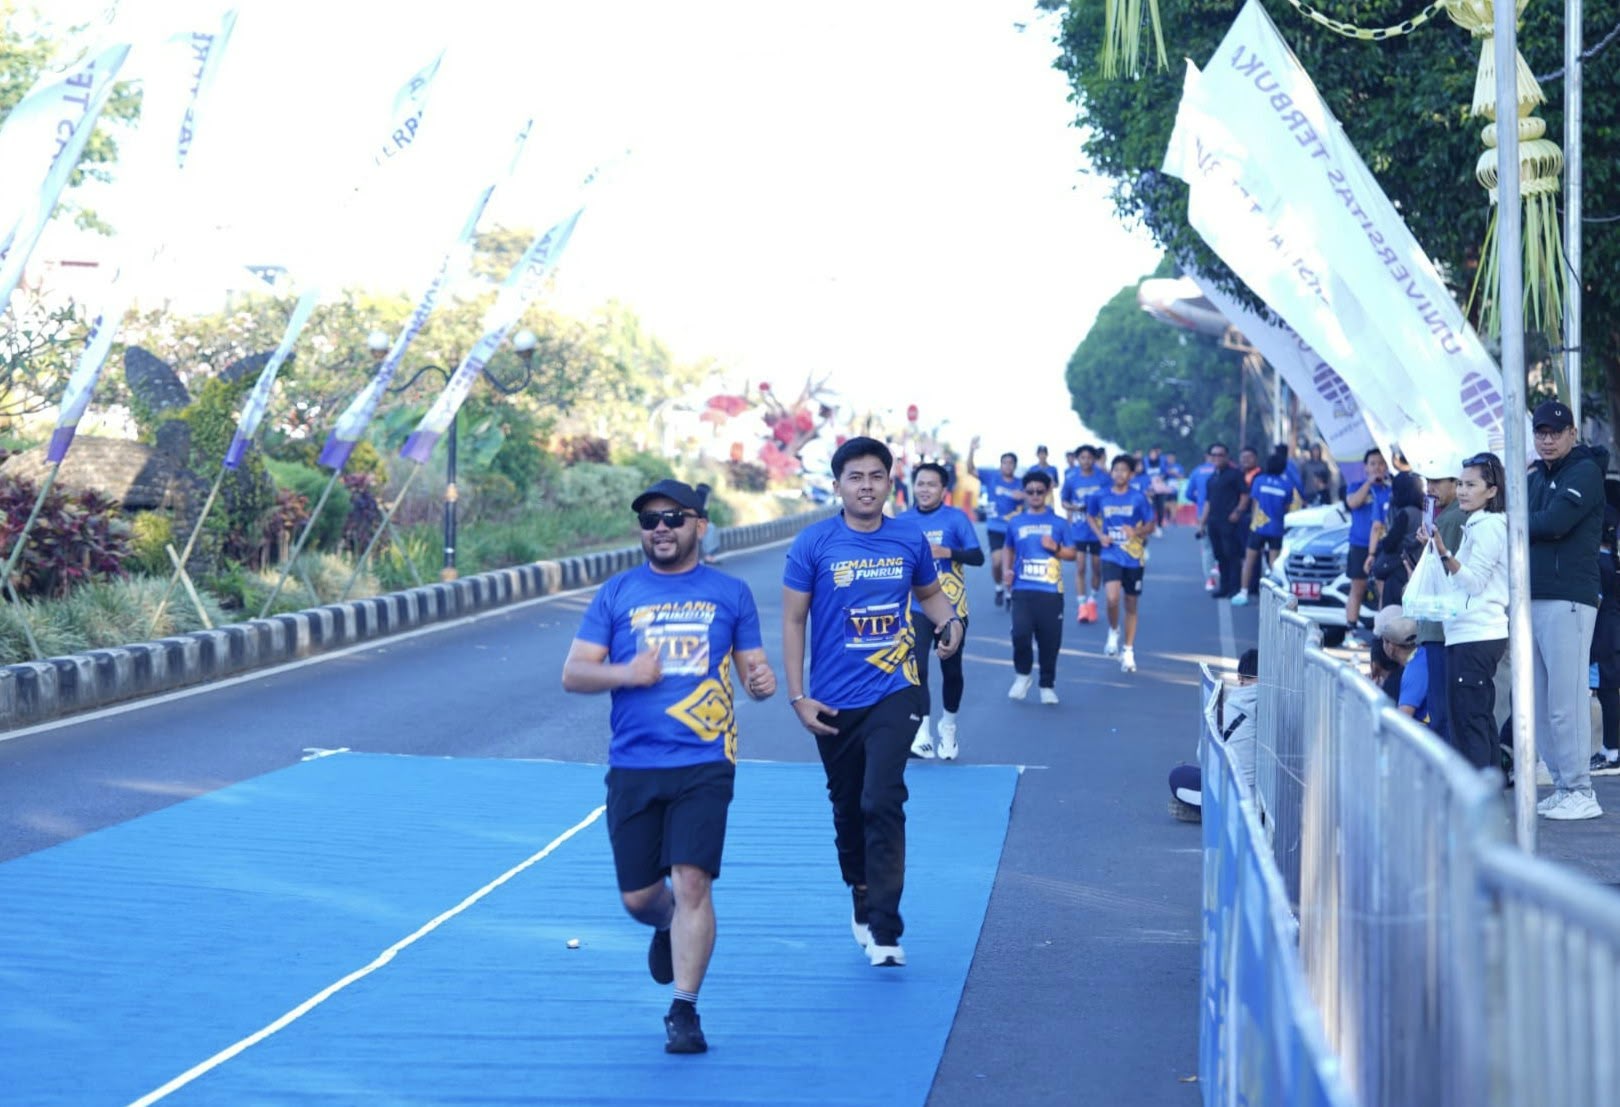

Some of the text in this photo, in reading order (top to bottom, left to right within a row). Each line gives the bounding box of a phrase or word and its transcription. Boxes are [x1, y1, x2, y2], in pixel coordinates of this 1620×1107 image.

[854, 566, 904, 581] FUNRUN
[850, 615, 895, 637] VIP
[644, 635, 700, 660] VIP
